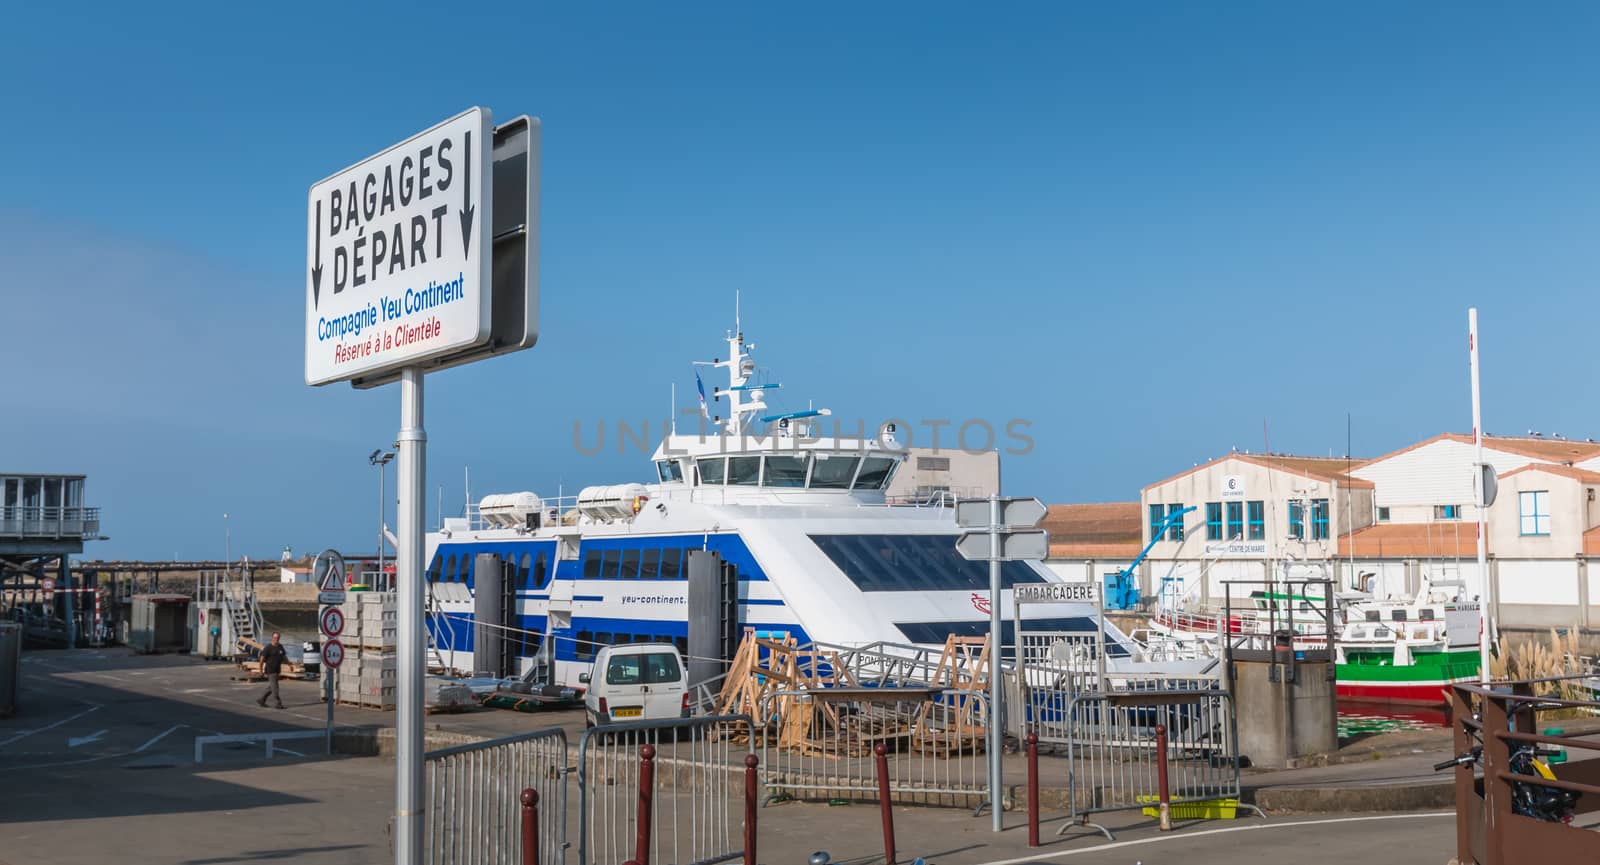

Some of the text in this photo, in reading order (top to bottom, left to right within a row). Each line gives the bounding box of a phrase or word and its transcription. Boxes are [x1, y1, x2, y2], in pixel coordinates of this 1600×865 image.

[330, 138, 453, 237] BAGAGES
[334, 204, 448, 294] DÉPART
[318, 271, 464, 341] Compagnie Yeu Continent
[334, 316, 441, 365] Réservé à la Clientèle
